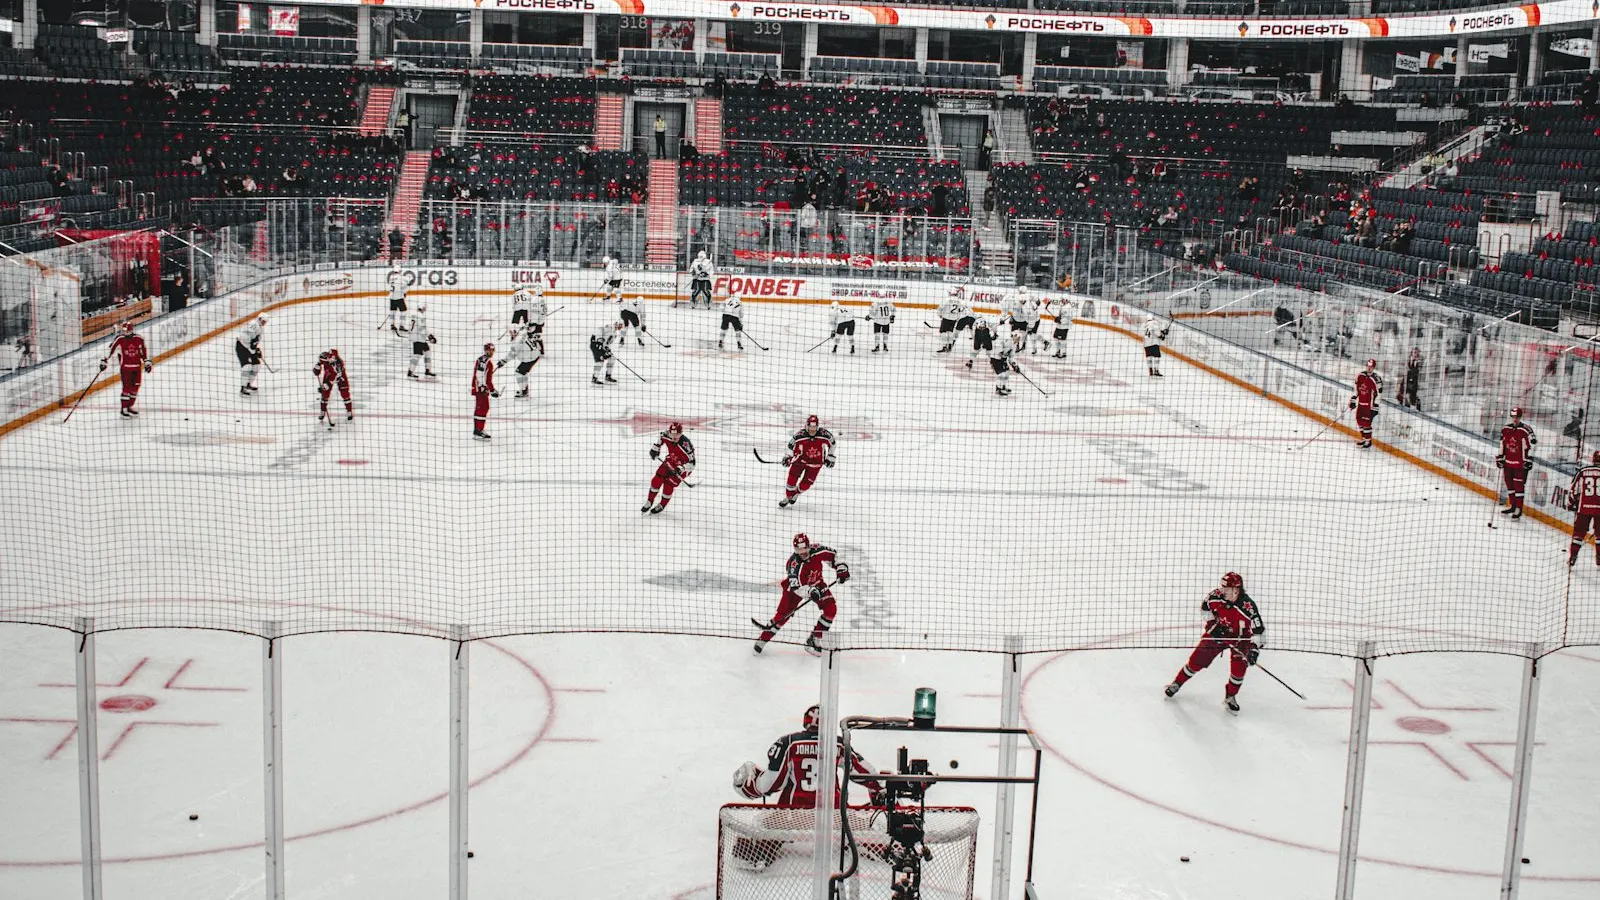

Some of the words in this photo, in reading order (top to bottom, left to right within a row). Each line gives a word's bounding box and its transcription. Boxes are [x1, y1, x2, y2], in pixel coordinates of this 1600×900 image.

[753, 7, 850, 20] РОСНЕФТЬ
[620, 16, 647, 28] 318
[753, 22, 781, 34] 319
[1008, 18, 1104, 31] РОСНЕФТЬ
[1463, 14, 1514, 29] РОСНЕФТЬ
[1260, 25, 1349, 35] РОСНЕФТЬ
[512, 271, 541, 284] ЦСКА
[713, 277, 805, 296] FONBET
[880, 306, 889, 316] 10
[769, 745, 781, 759] 31
[801, 758, 819, 792] 3
